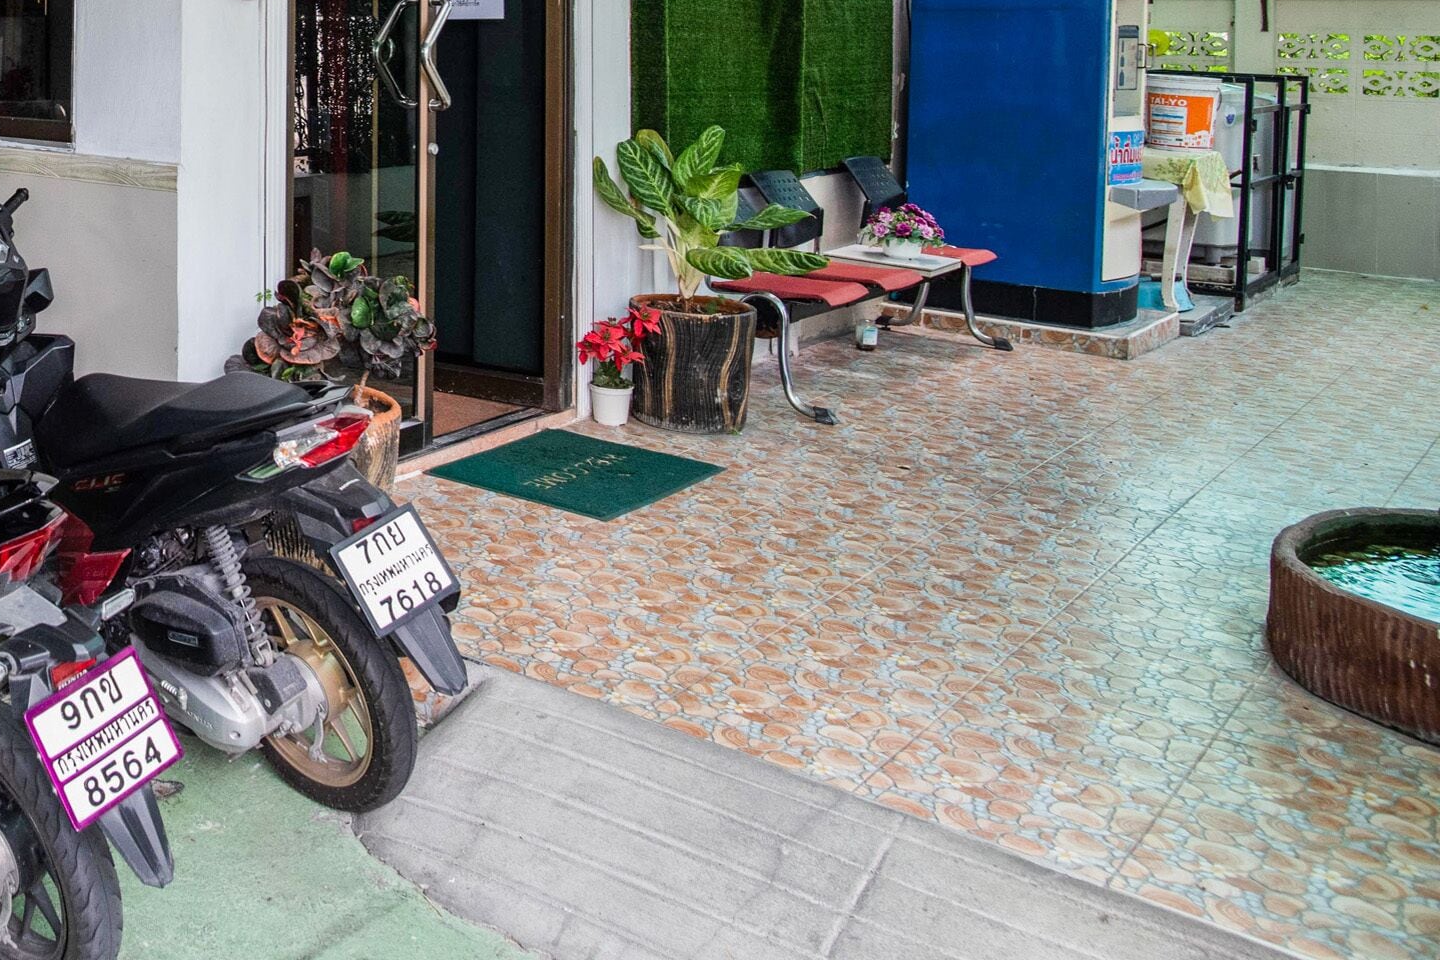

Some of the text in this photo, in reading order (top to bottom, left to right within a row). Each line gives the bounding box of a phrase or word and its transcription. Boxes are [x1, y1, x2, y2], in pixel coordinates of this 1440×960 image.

[355, 521, 406, 564] 7กย
[359, 543, 434, 596] กรุงเทพมหานคร
[380, 571, 442, 621] 7618
[60, 670, 123, 730] 9กข
[57, 700, 155, 775] กรุงเทพมหานคร
[83, 736, 162, 807] 8564
